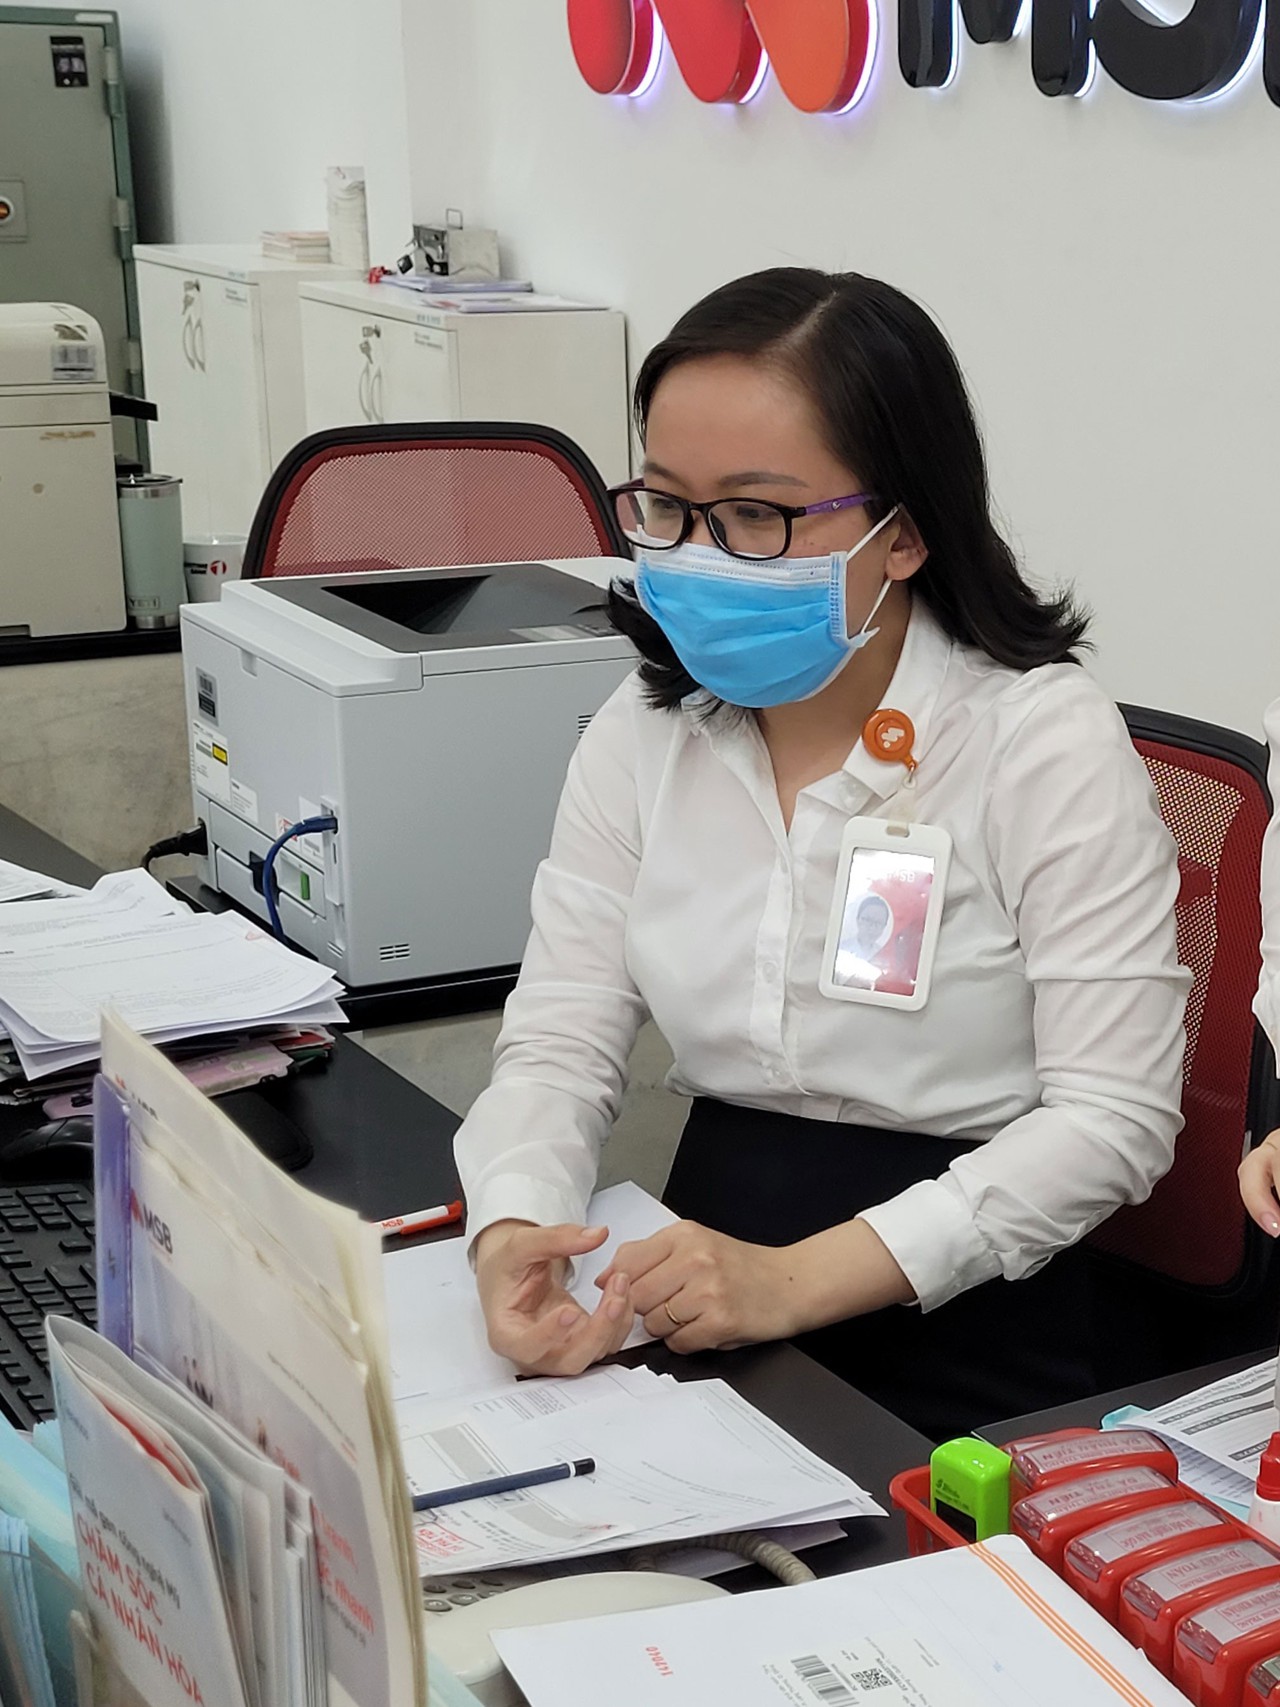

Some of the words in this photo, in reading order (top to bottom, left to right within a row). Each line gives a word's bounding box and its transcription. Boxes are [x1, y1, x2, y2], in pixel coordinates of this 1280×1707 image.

[143, 1204, 173, 1254] MSB
[382, 1218, 403, 1229] MSB
[77, 1512, 123, 1585] CHĂM
[126, 1563, 163, 1626] SÓC
[86, 1562, 110, 1609] CÁ
[110, 1588, 163, 1665] NHÂN
